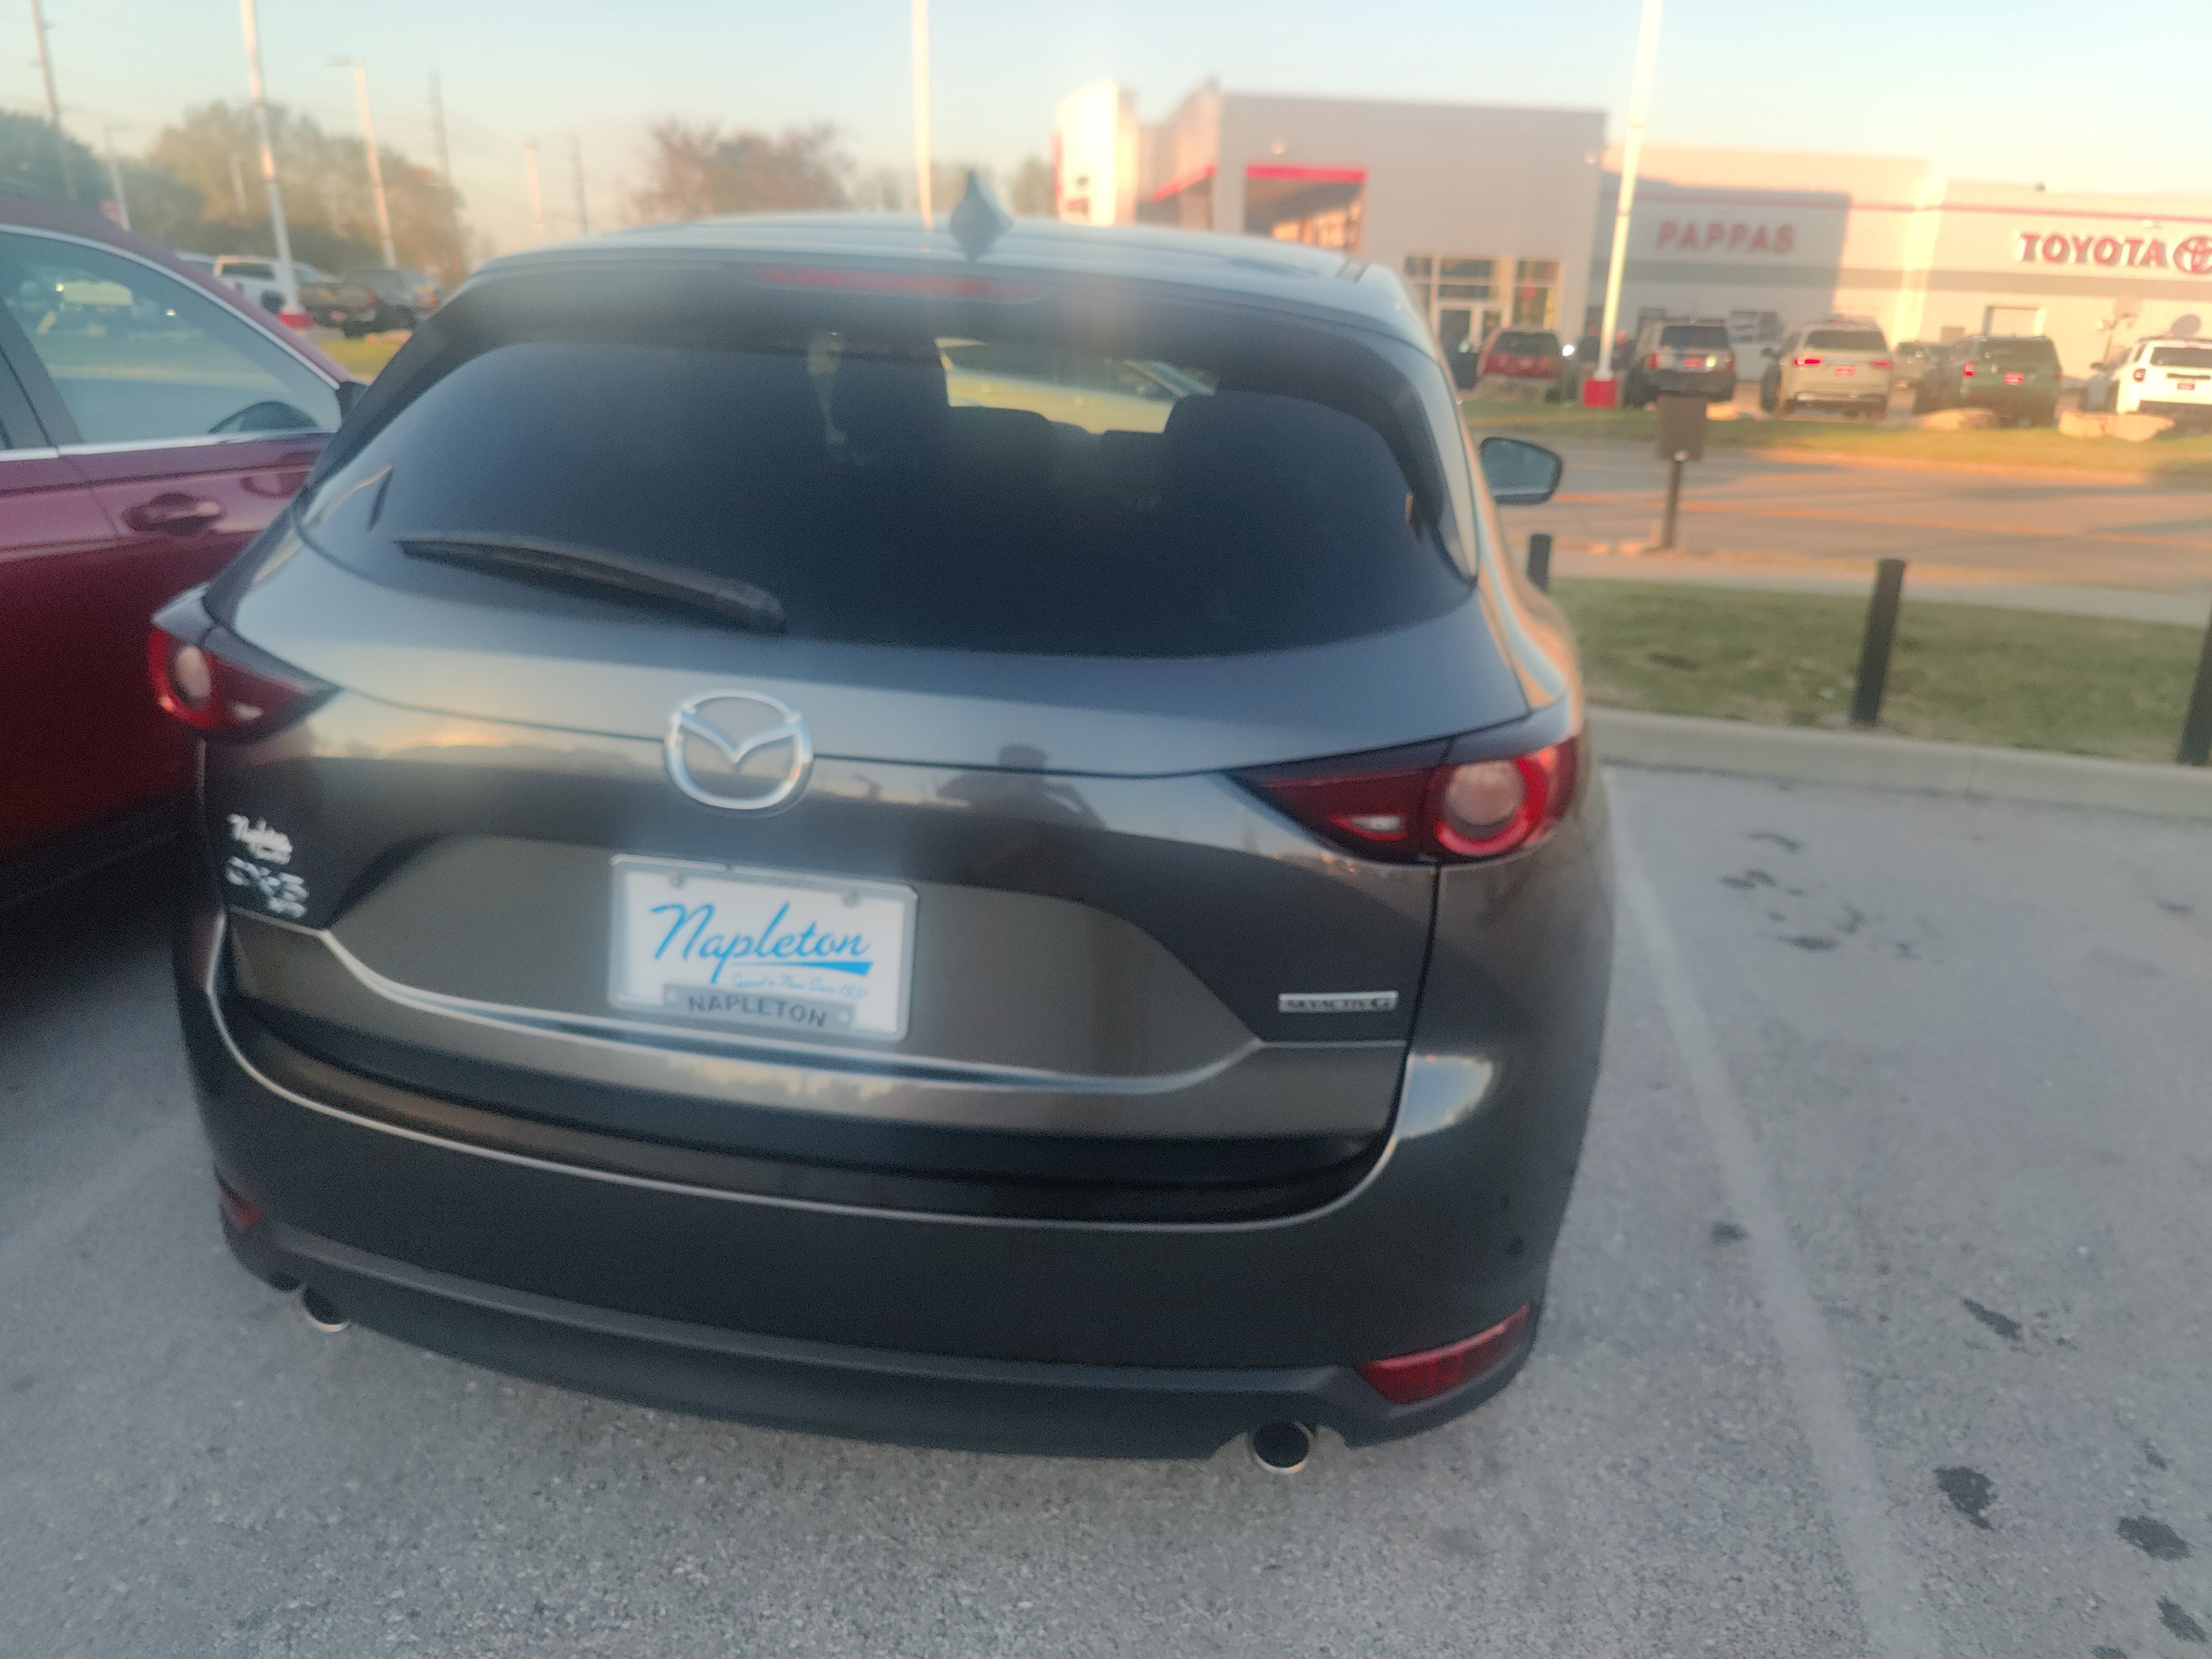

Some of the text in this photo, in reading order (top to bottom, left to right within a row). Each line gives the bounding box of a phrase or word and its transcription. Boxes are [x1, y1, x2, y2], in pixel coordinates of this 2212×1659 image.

[1656, 220, 1796, 254] PAPPAS
[2018, 233, 2168, 267] TOYOTA
[650, 901, 870, 984] Napleton
[687, 994, 828, 1027] NAPLETON
